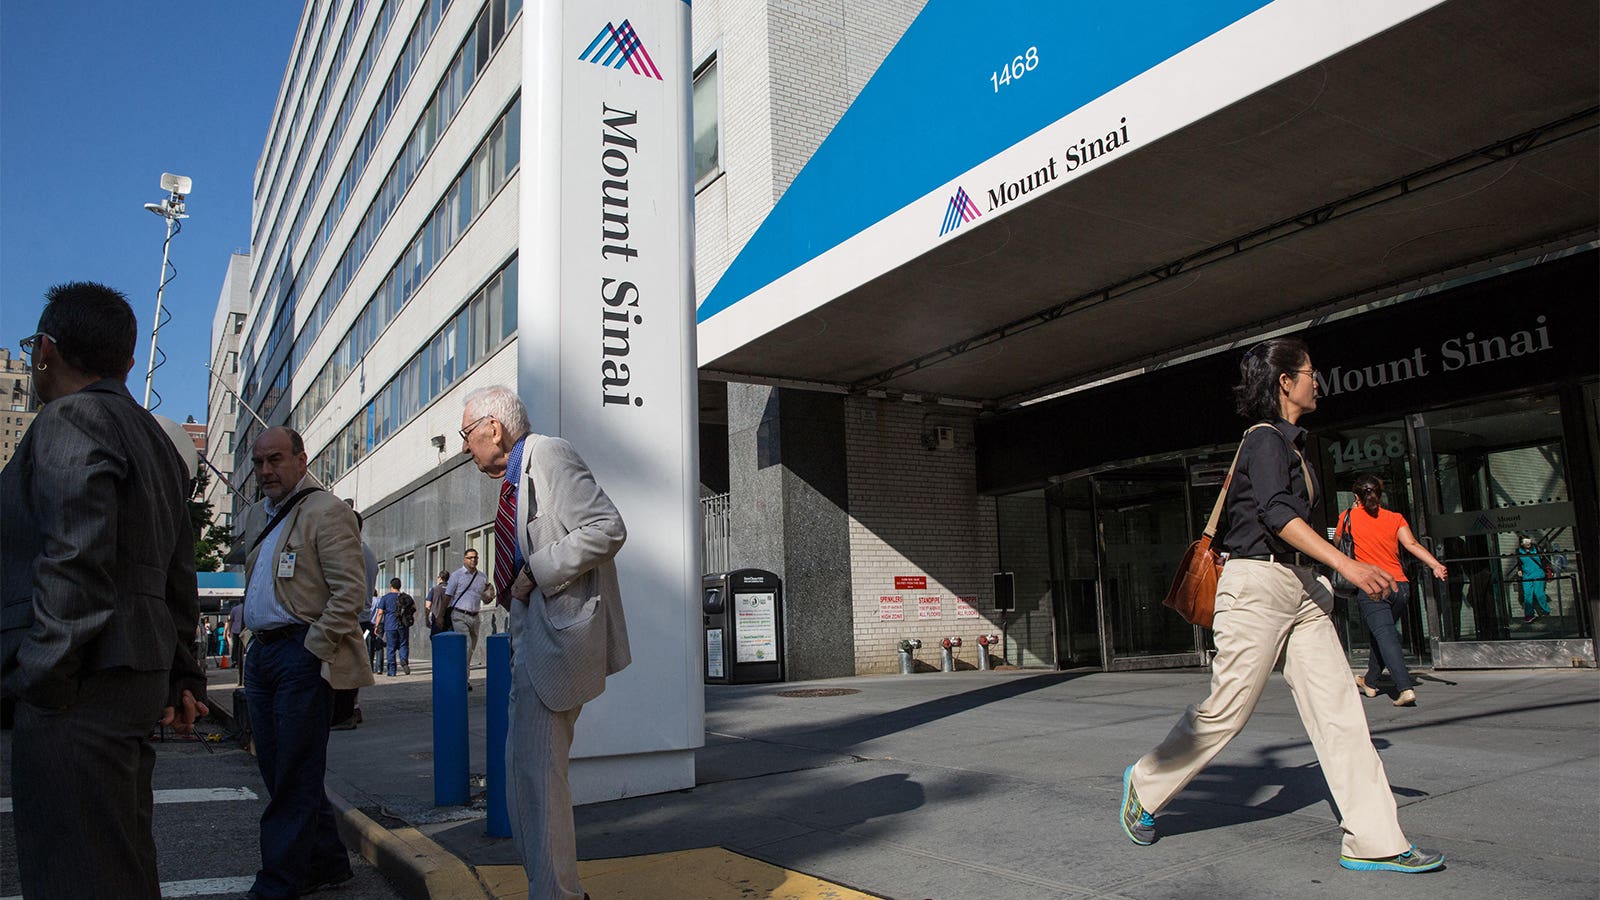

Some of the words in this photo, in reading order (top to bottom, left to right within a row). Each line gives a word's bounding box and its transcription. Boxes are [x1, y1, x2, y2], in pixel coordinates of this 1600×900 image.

[990, 46, 1039, 93] 1468
[601, 101, 638, 262] Mount
[987, 157, 1058, 212] Mount
[1065, 117, 1130, 173] Sinai
[601, 277, 643, 407] Sinai
[1316, 347, 1430, 399] Mount
[1441, 315, 1553, 372] Sinai
[1328, 431, 1405, 465] 1468
